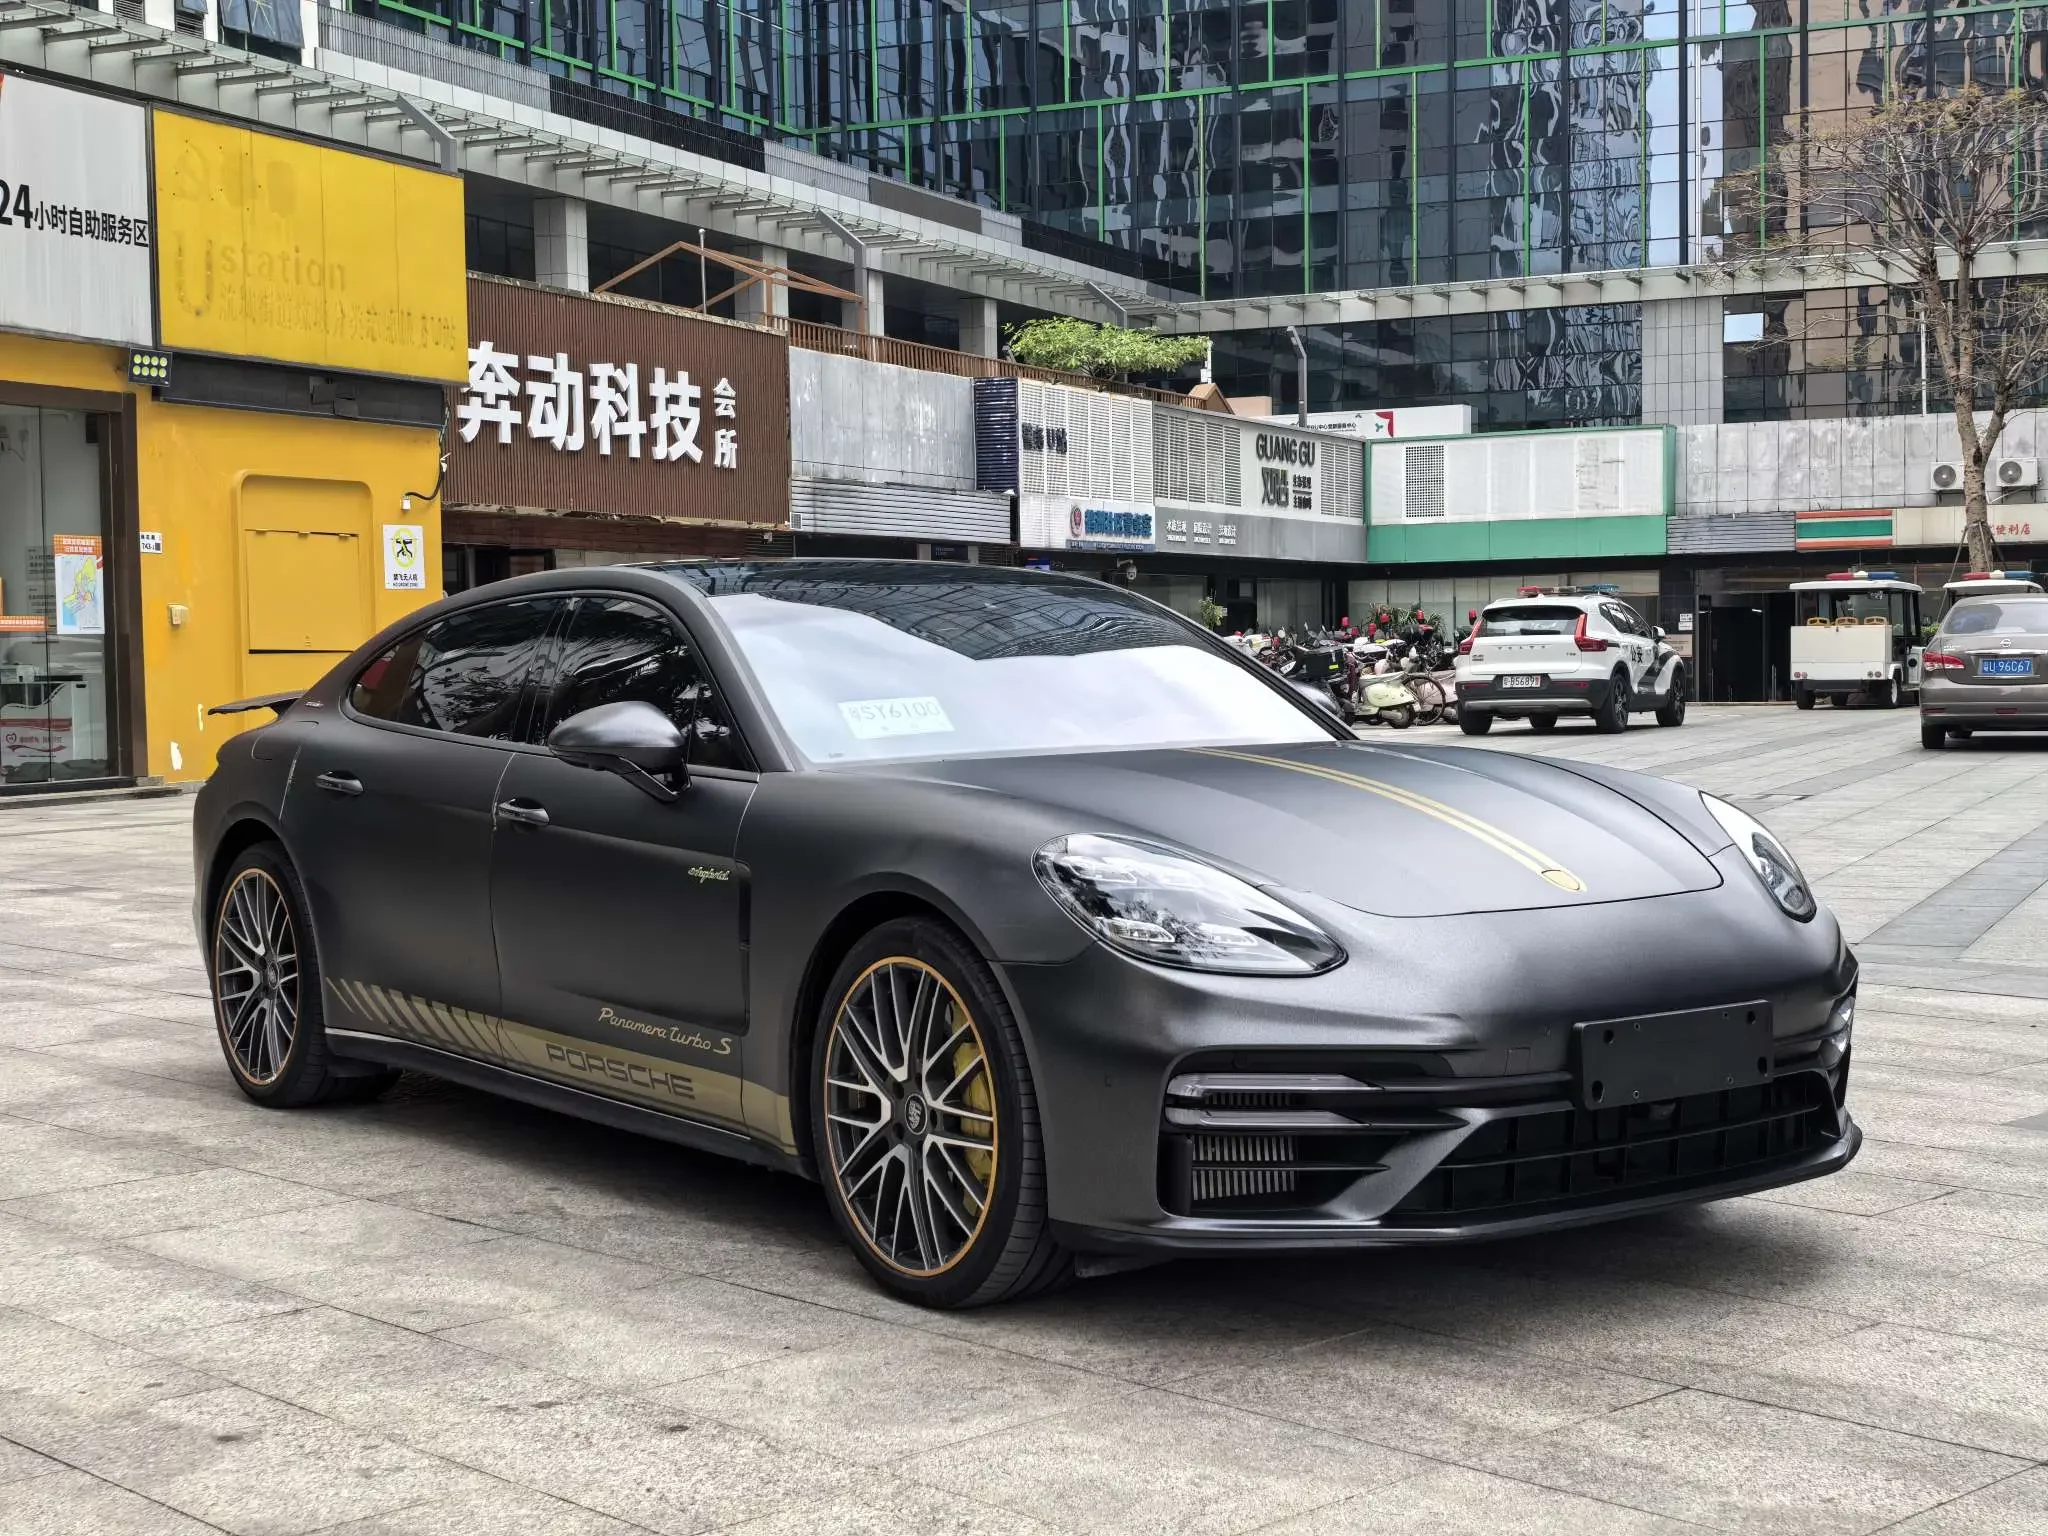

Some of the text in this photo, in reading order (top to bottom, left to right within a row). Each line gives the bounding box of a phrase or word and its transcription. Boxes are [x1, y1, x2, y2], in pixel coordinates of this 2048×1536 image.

[0, 178, 149, 248] 24小时自助服务区
[457, 340, 703, 463] 奔动科技
[713, 377, 738, 469] 会所
[1256, 433, 1316, 467] GUANG GU
[1630, 643, 1643, 664] 公安
[598, 1007, 733, 1055] Panamera Turbo S
[545, 1042, 696, 1100] PORSCHE
